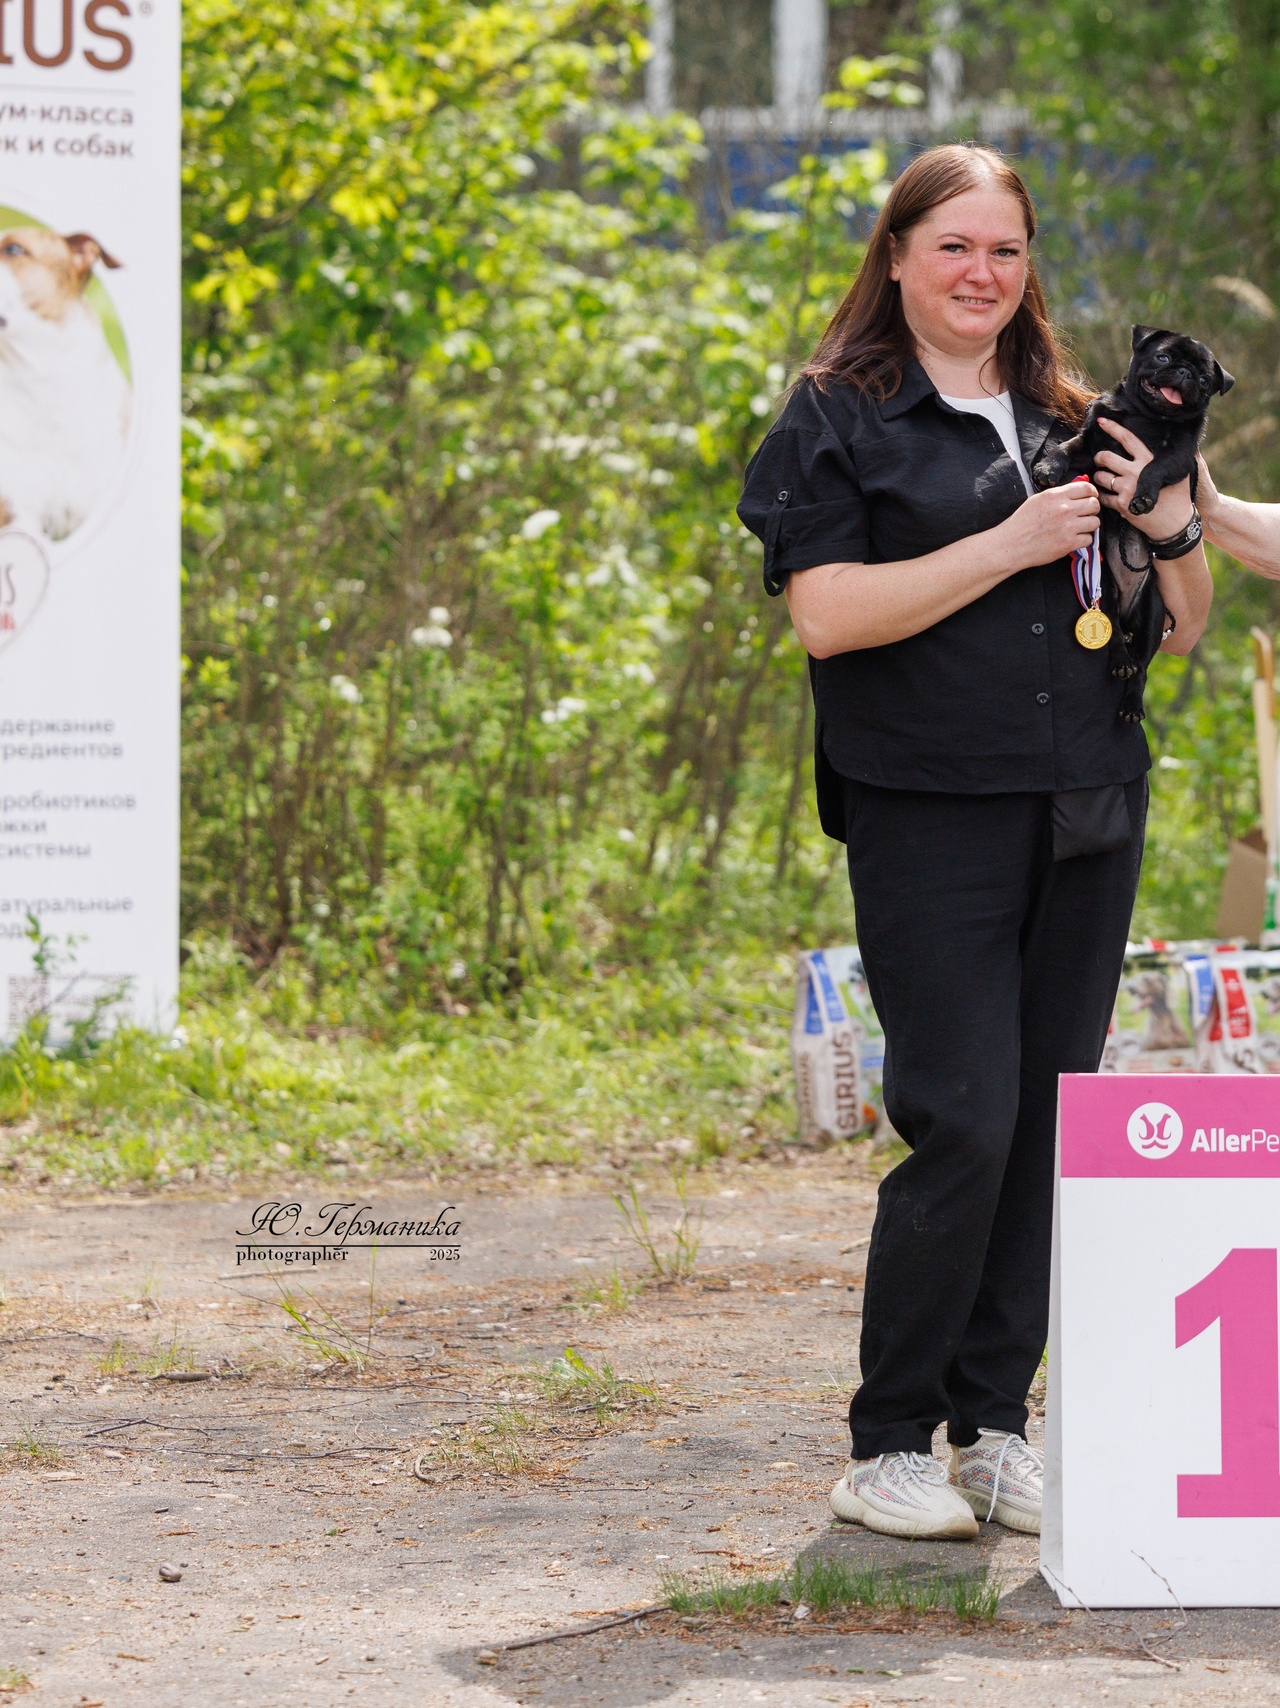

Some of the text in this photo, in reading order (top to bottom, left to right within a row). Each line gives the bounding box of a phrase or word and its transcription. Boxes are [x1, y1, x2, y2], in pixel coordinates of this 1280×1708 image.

[54, 133, 134, 159] собак
[0, 789, 137, 812] робиотиков
[833, 1029, 858, 1131] SIRIUS
